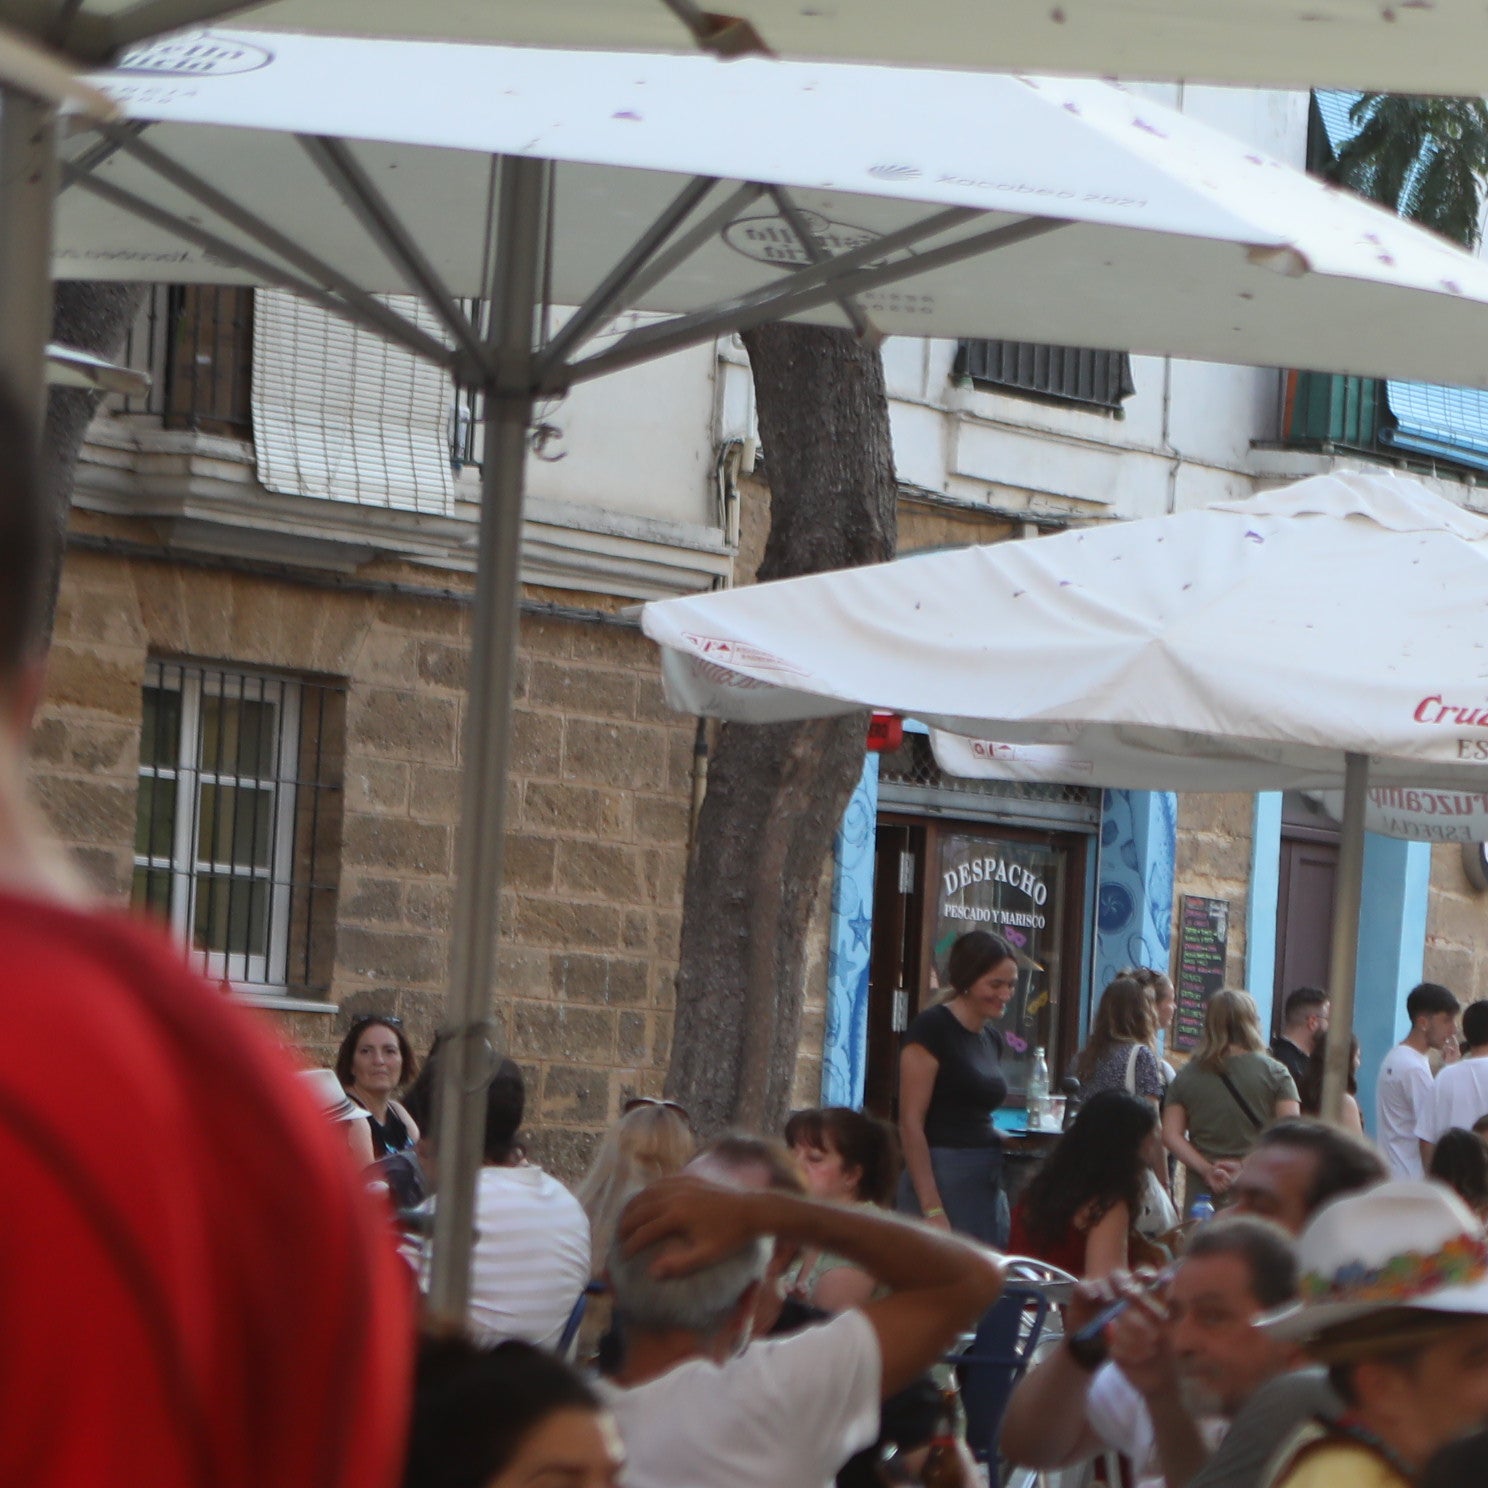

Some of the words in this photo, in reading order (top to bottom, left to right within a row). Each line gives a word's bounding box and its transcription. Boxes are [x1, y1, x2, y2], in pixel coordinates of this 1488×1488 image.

[936, 175, 1075, 199] Xacobeo
[943, 858, 1048, 906] DESPACHO
[944, 903, 991, 921] PESCADO
[991, 910, 1000, 924] Y
[1001, 911, 1046, 929] MARISCO
